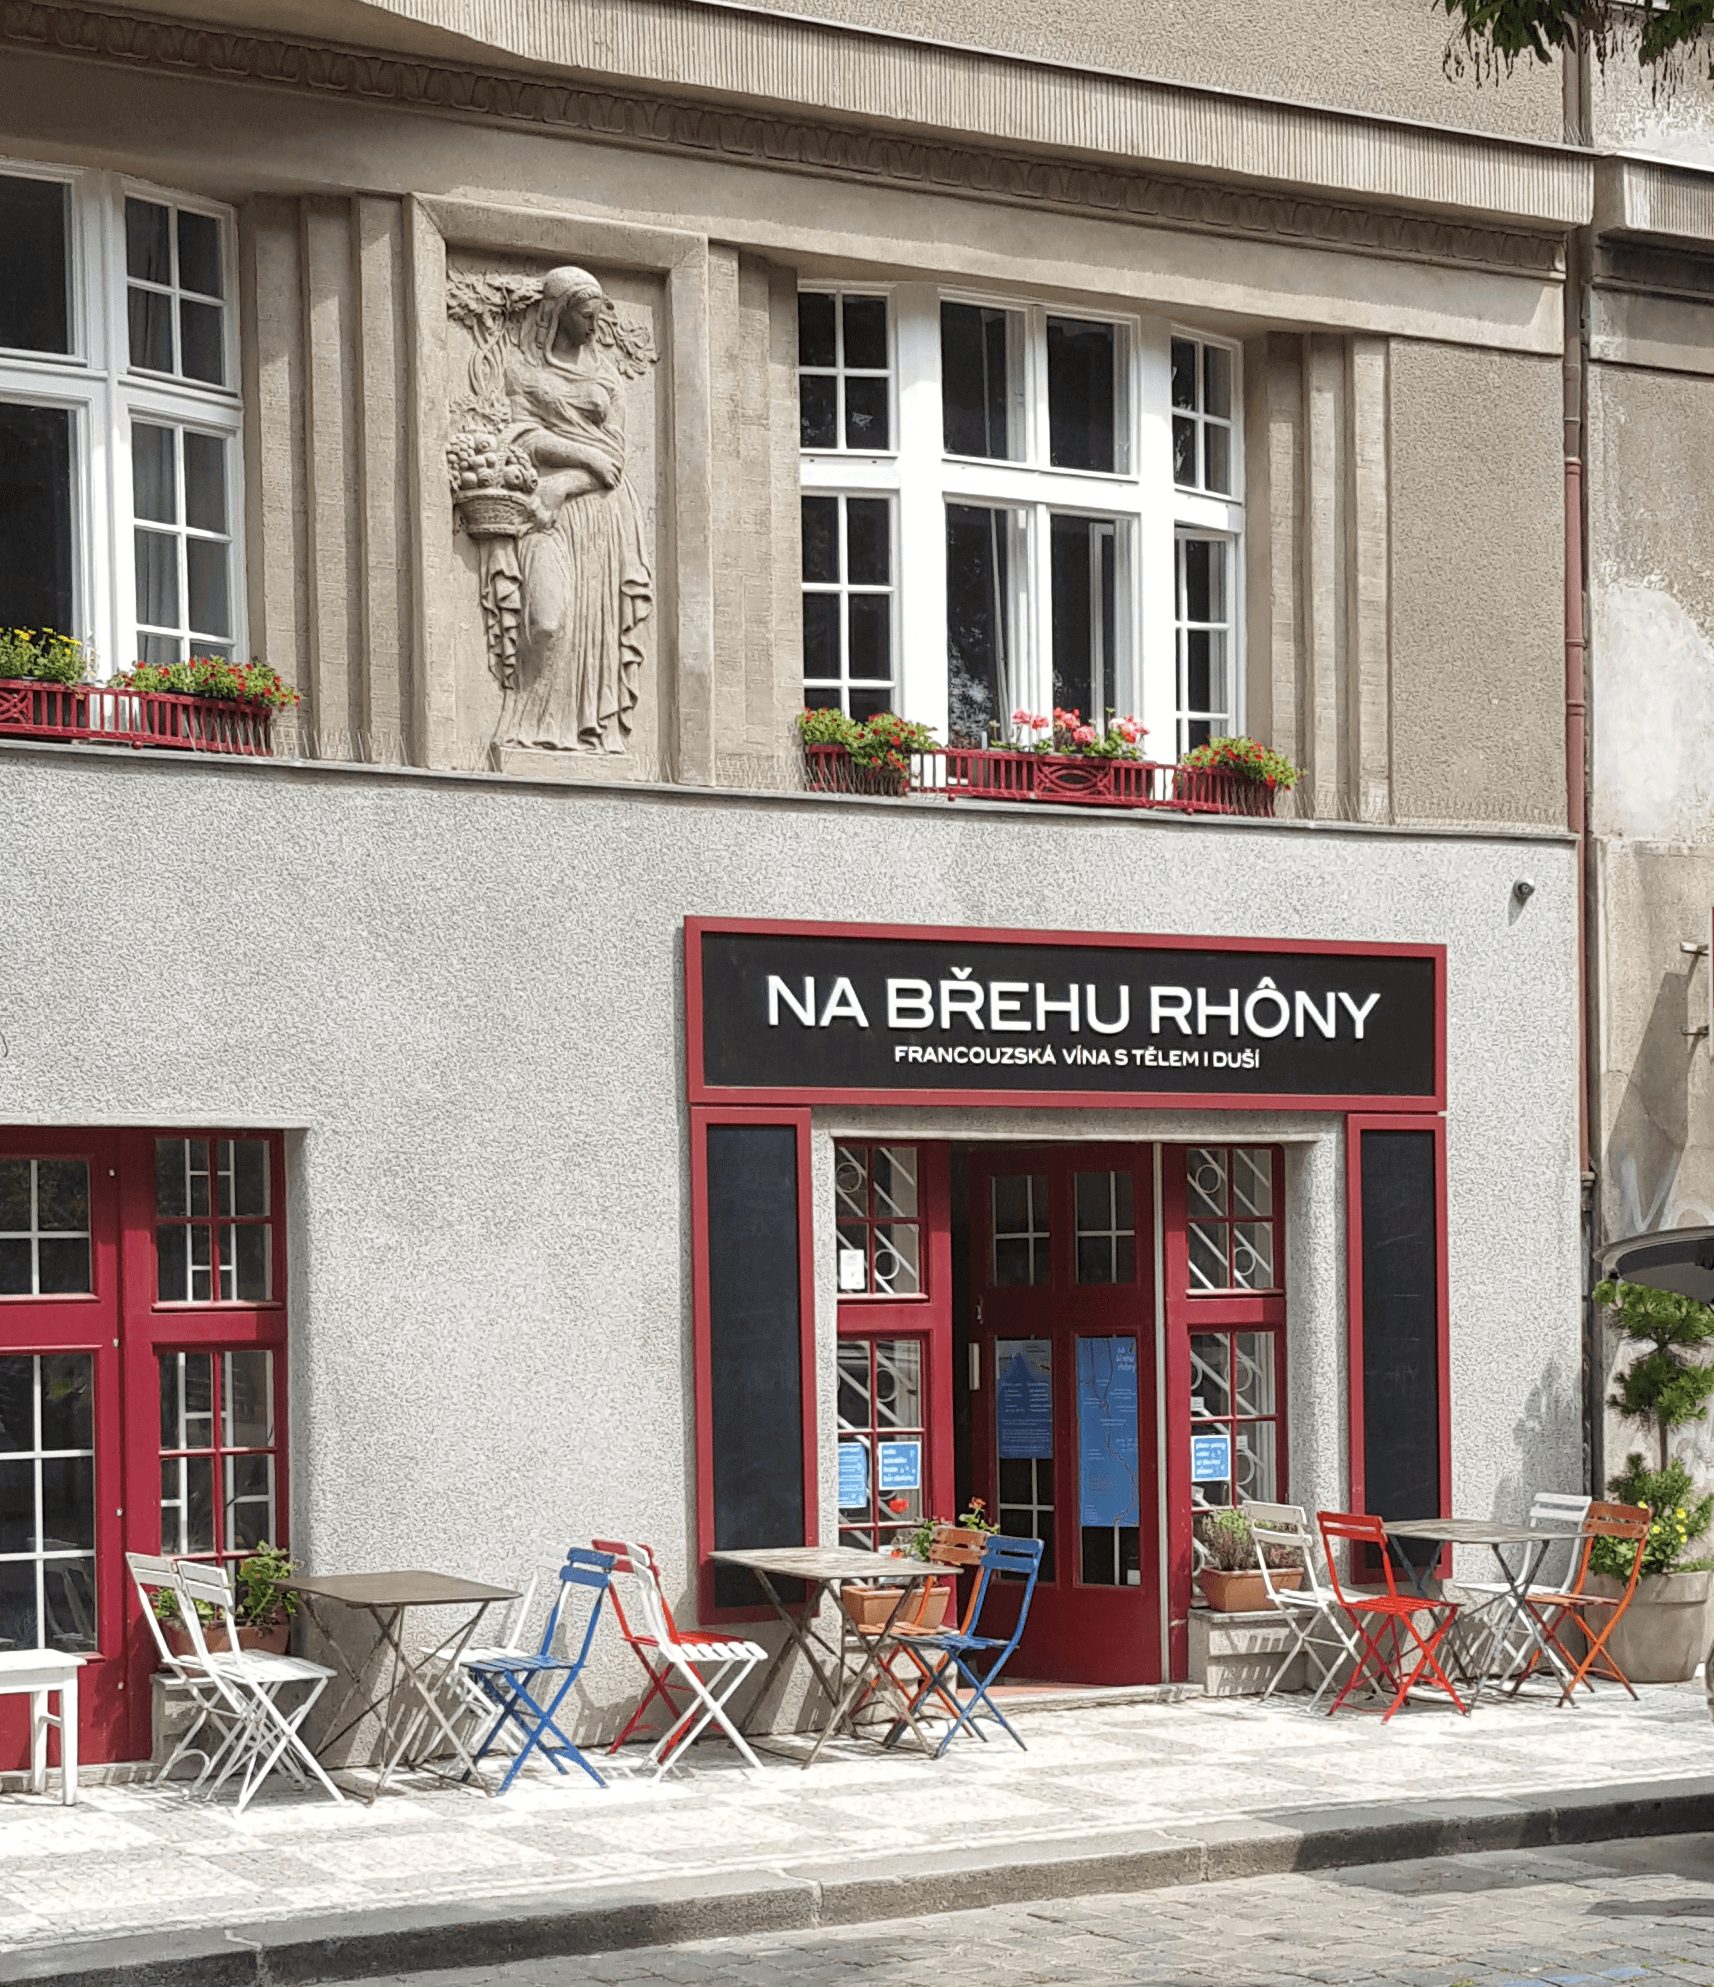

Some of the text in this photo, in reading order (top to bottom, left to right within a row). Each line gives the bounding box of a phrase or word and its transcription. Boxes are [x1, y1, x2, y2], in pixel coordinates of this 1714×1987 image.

[767, 966, 1381, 1039] NA BŘEHU RHÔNY
[894, 1044, 1260, 1069] FRANCOUZSKÁ VÍNA S TĚLEM I DUŠÍ
